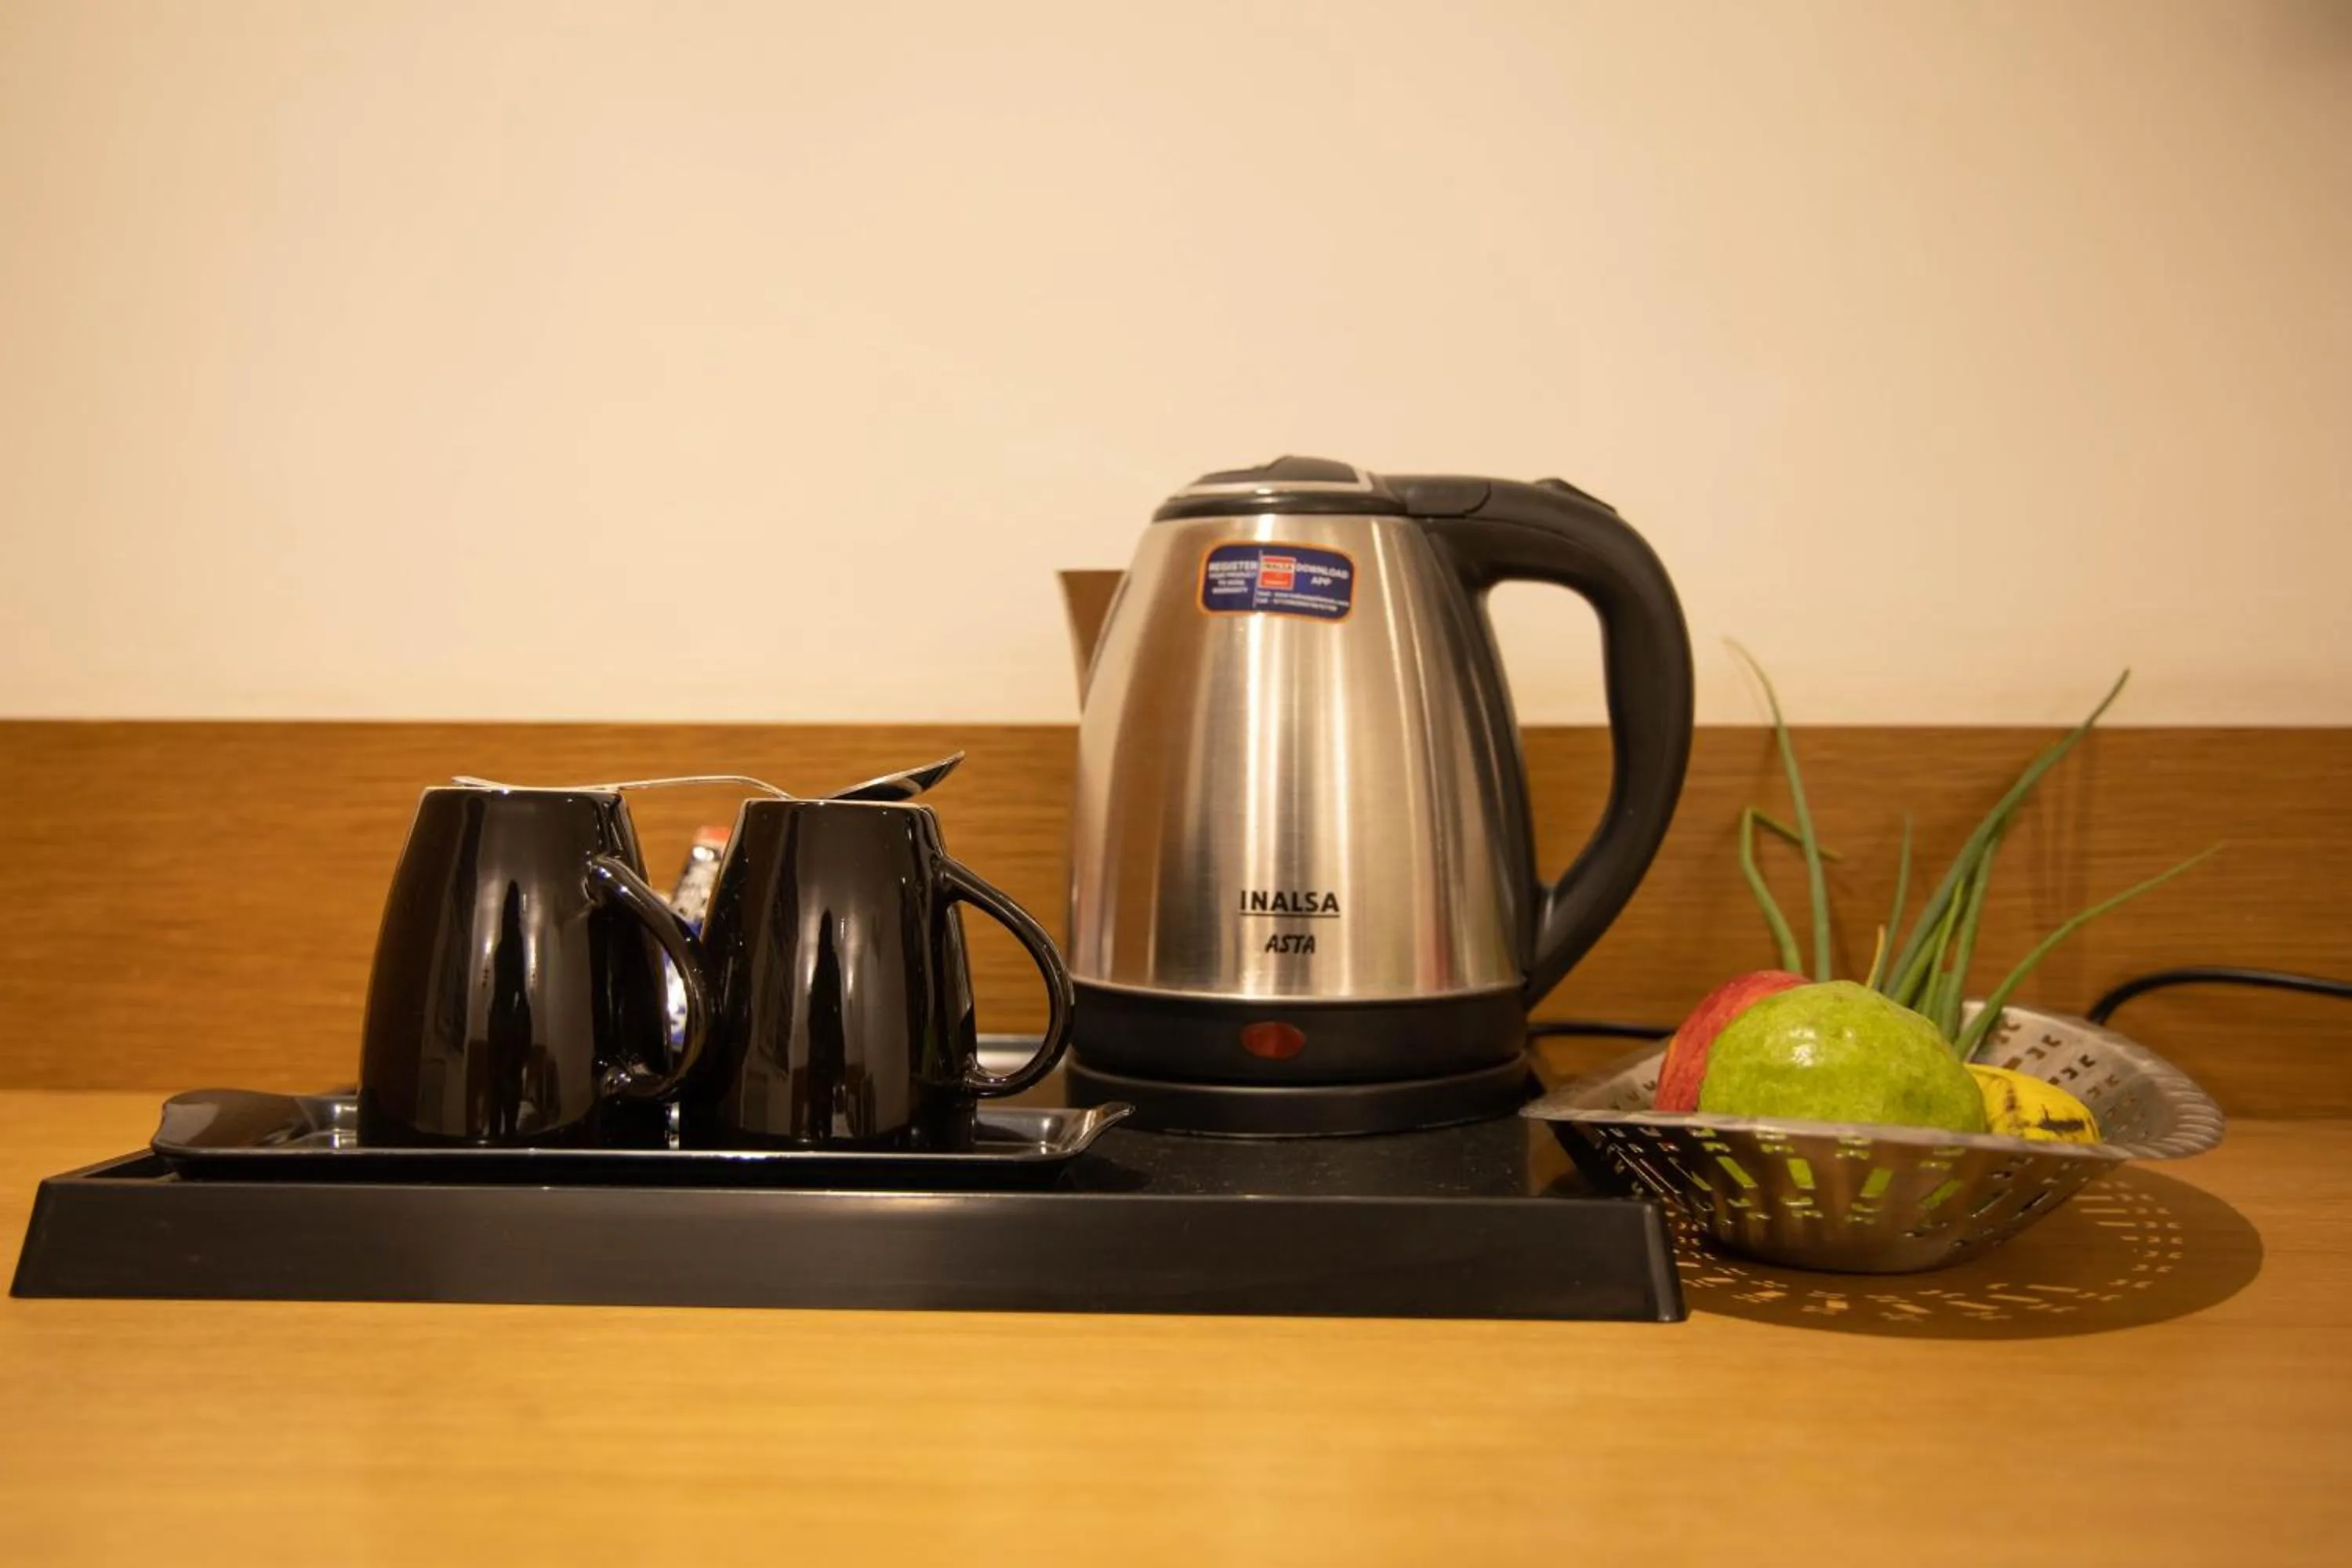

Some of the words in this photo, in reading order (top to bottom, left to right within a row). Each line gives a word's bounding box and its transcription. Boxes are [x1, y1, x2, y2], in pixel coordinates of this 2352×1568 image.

[1208, 561, 1258, 572] REGISTER
[1295, 562, 1350, 579] DOWNLOAD
[1310, 576, 1333, 586] APP
[1240, 891, 1339, 912] INALSA
[1265, 935, 1316, 954] ASTA
